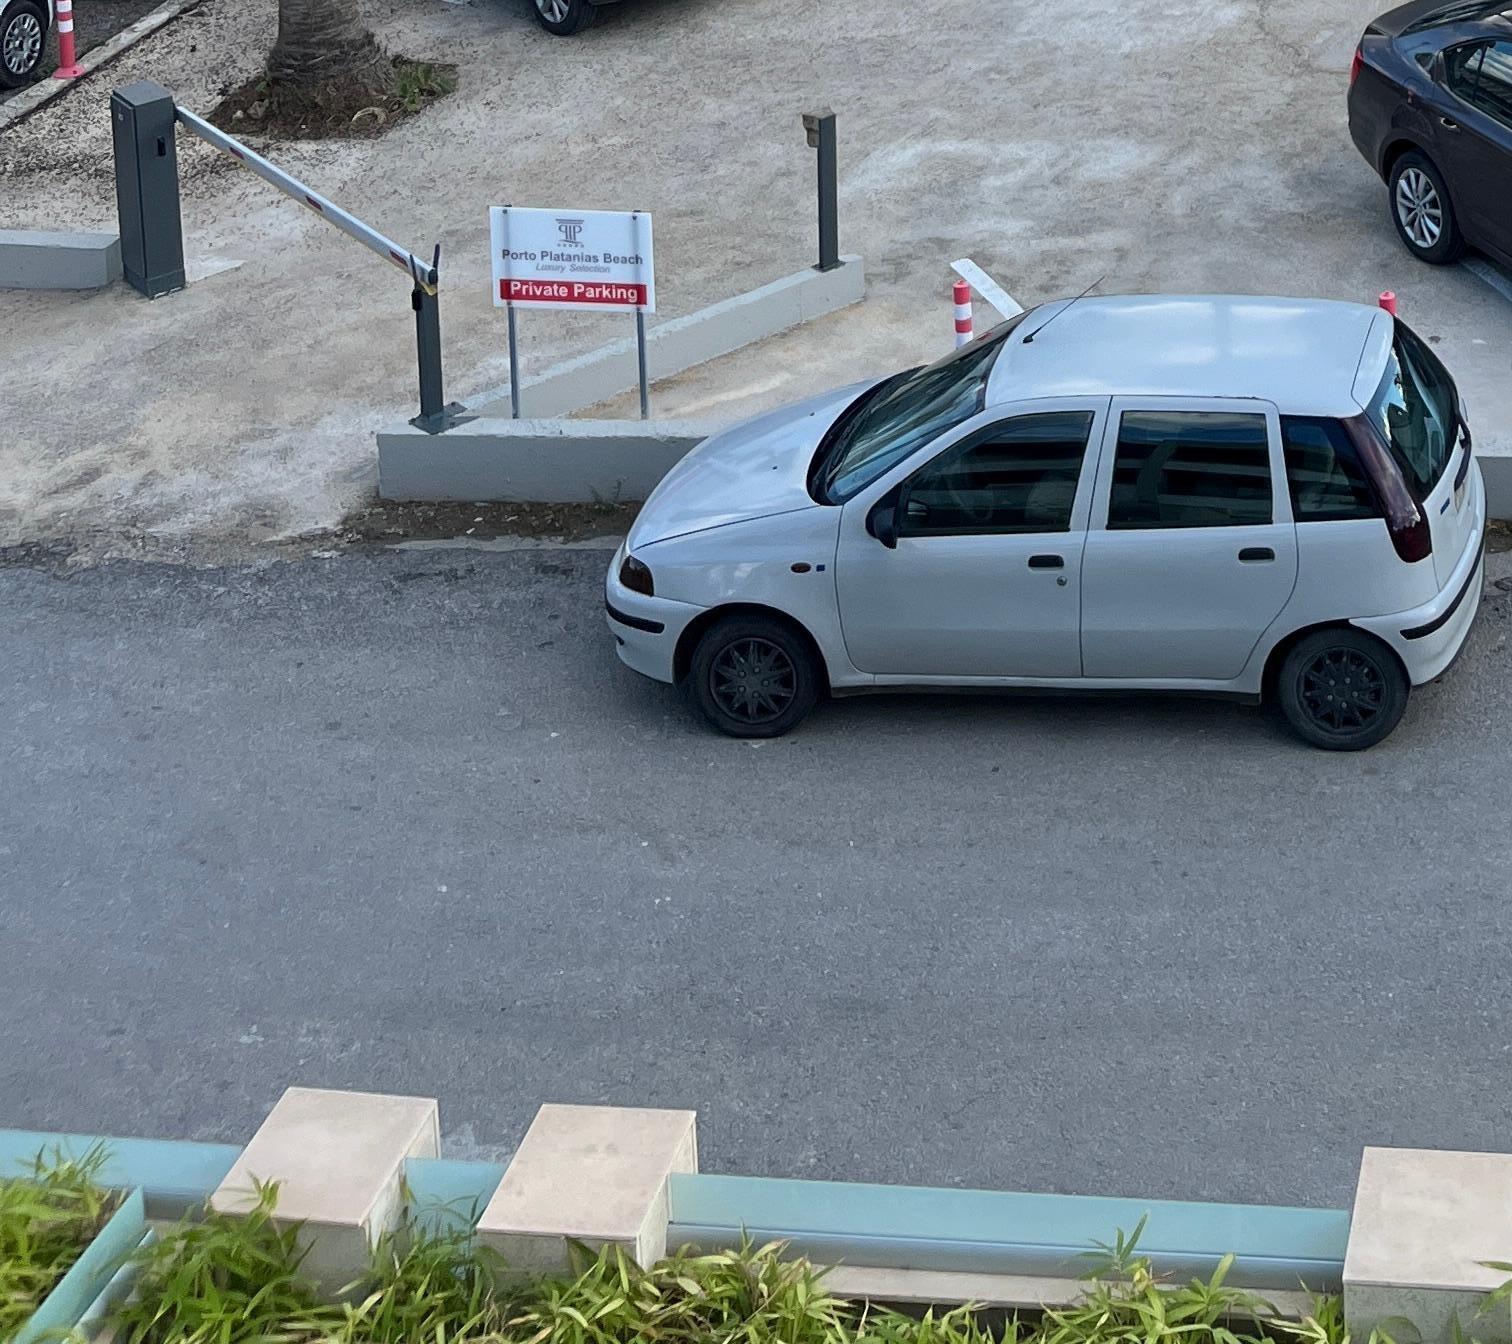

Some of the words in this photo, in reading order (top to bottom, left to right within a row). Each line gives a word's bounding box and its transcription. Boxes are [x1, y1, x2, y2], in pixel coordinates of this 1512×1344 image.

[502, 249, 537, 261] Porto
[541, 250, 599, 263] Platanias
[603, 253, 644, 265] Beach
[536, 263, 566, 274] Luxury
[569, 264, 611, 274] Selection
[510, 281, 569, 297] Private
[574, 284, 638, 303] Parking
